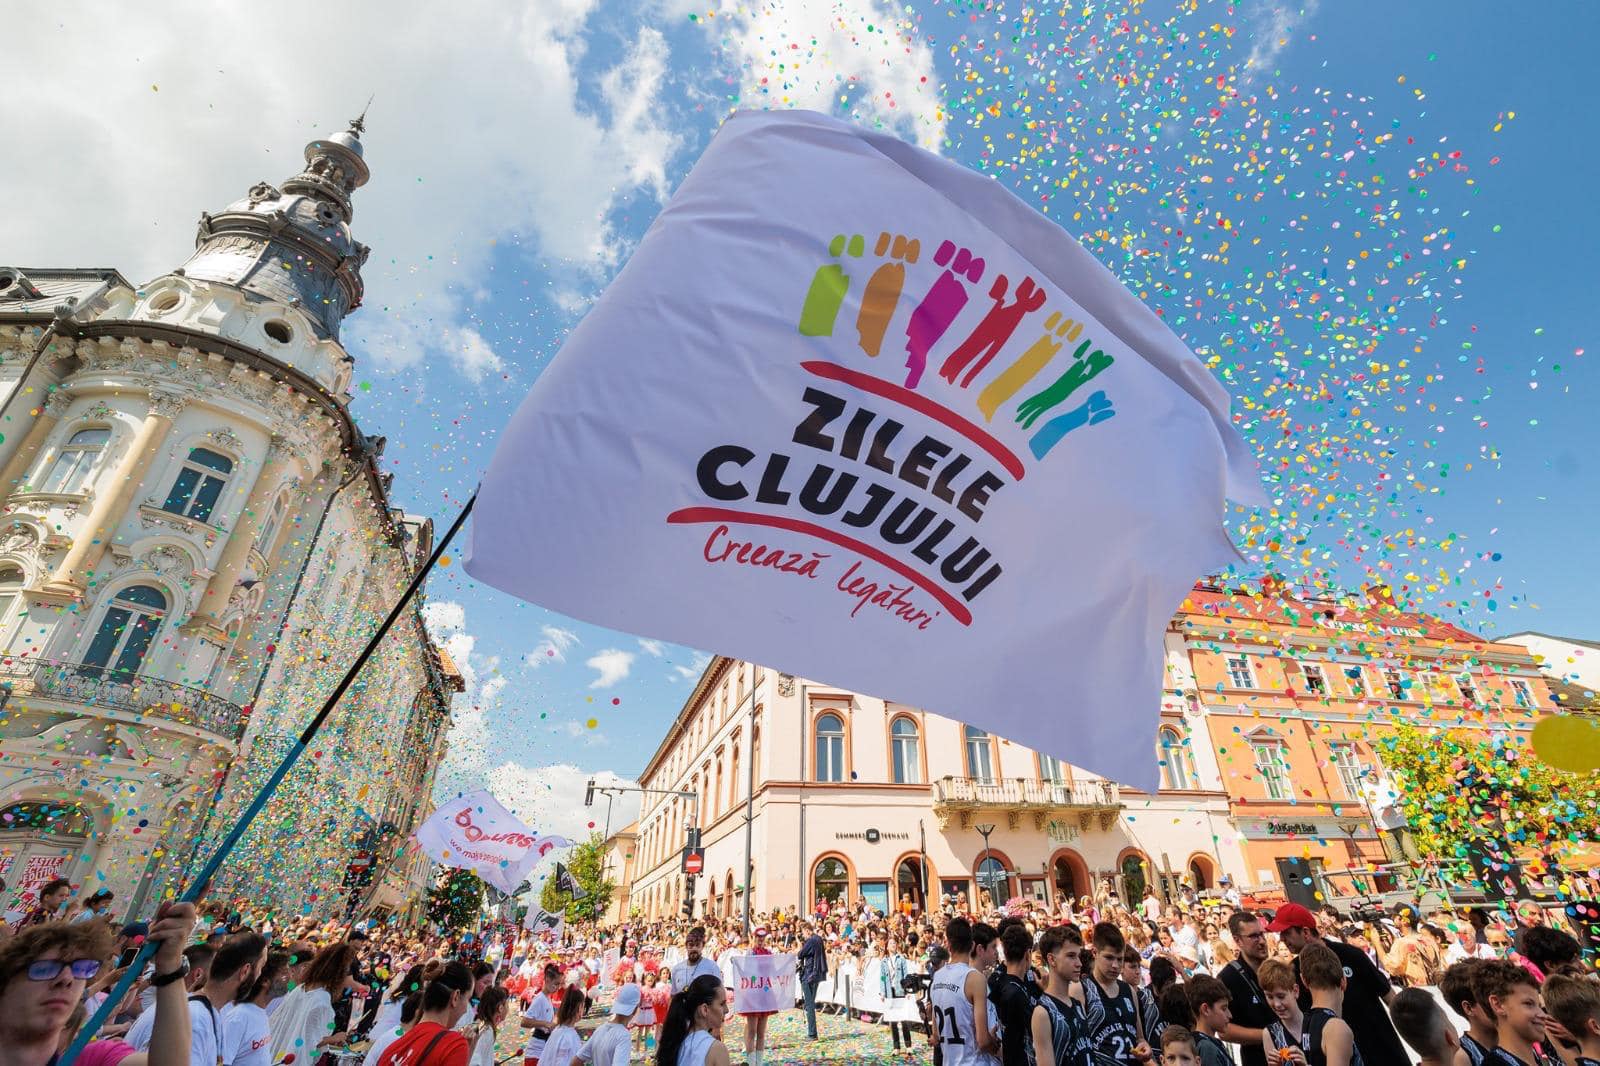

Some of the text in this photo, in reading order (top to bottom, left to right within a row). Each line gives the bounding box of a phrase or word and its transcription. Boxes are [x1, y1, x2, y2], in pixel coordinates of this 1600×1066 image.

[792, 387, 1005, 523] ZILELE
[696, 445, 1002, 602] CLUJULUI
[704, 525, 940, 629] Creează legături
